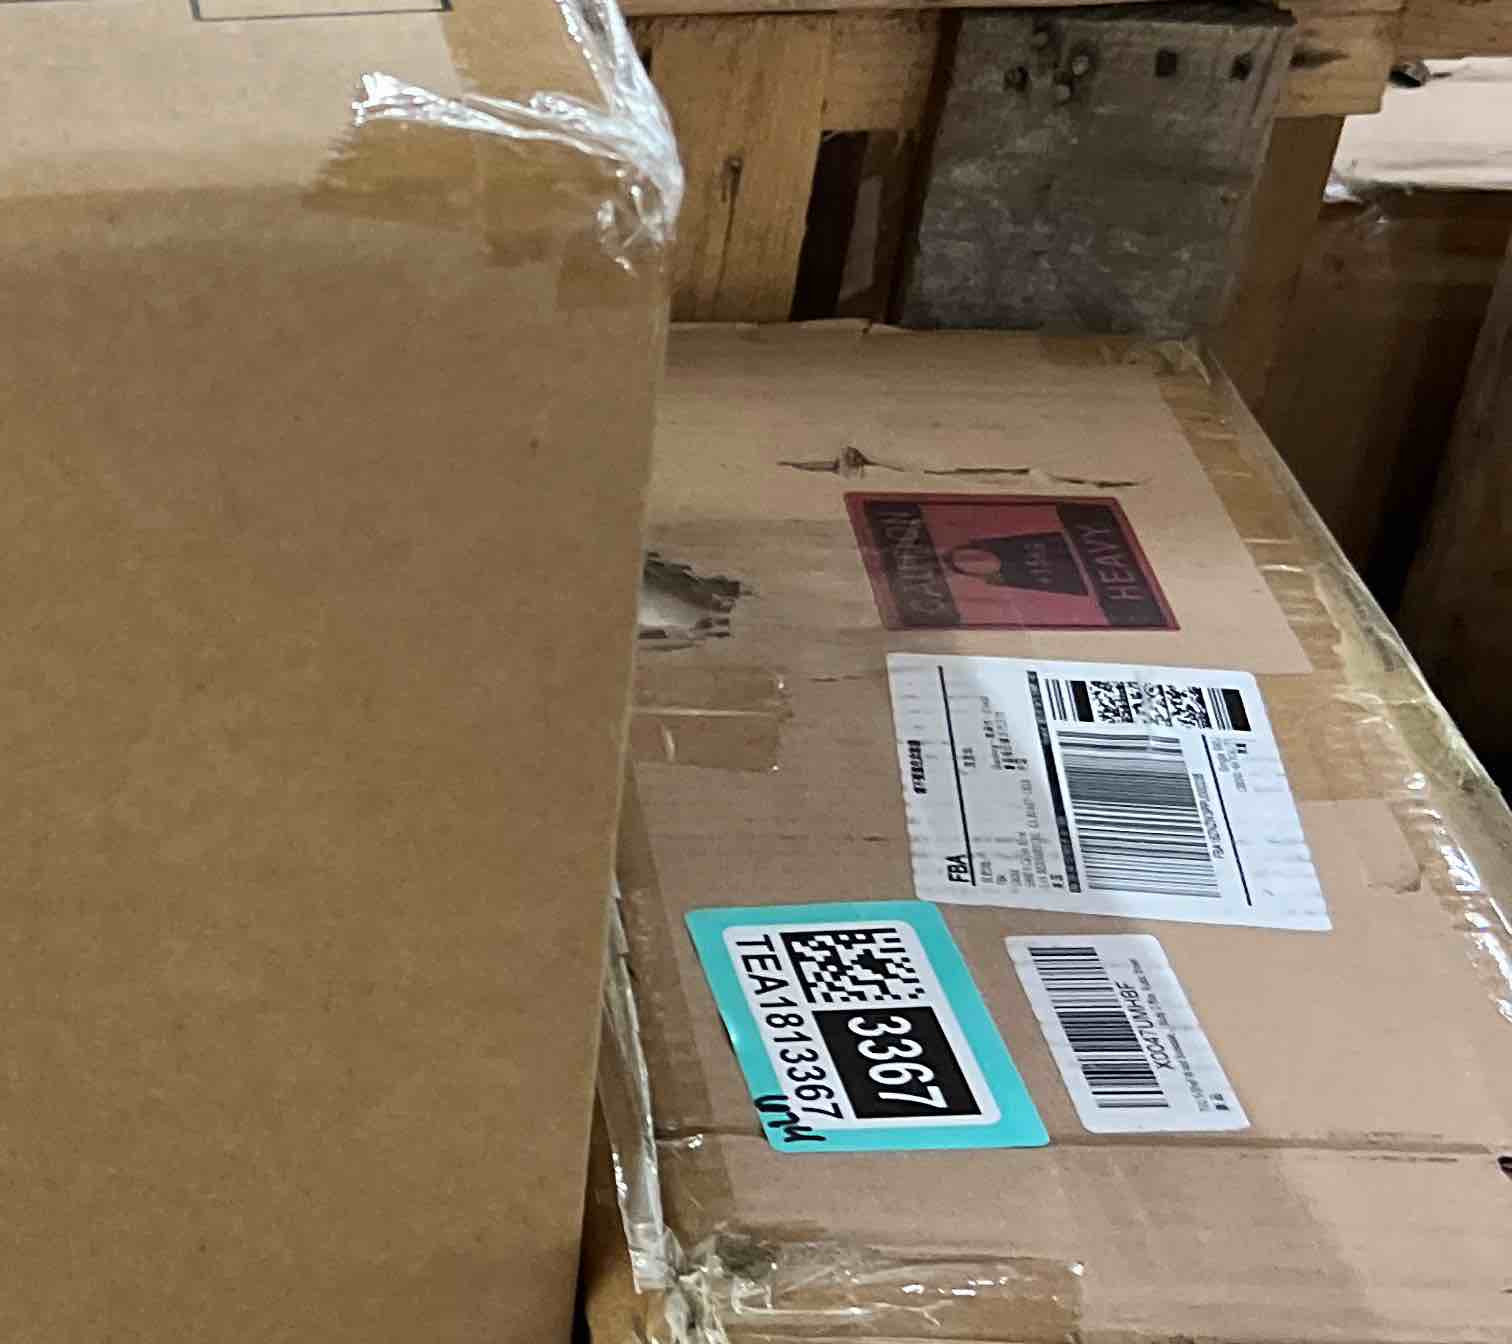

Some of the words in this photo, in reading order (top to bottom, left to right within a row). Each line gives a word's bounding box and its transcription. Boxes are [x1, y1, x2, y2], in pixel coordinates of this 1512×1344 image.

[1080, 524, 1145, 602] HEAVY
[948, 854, 970, 884] FBA
[735, 934, 845, 1120] TEA1813367
[847, 1014, 949, 1109] 3367
